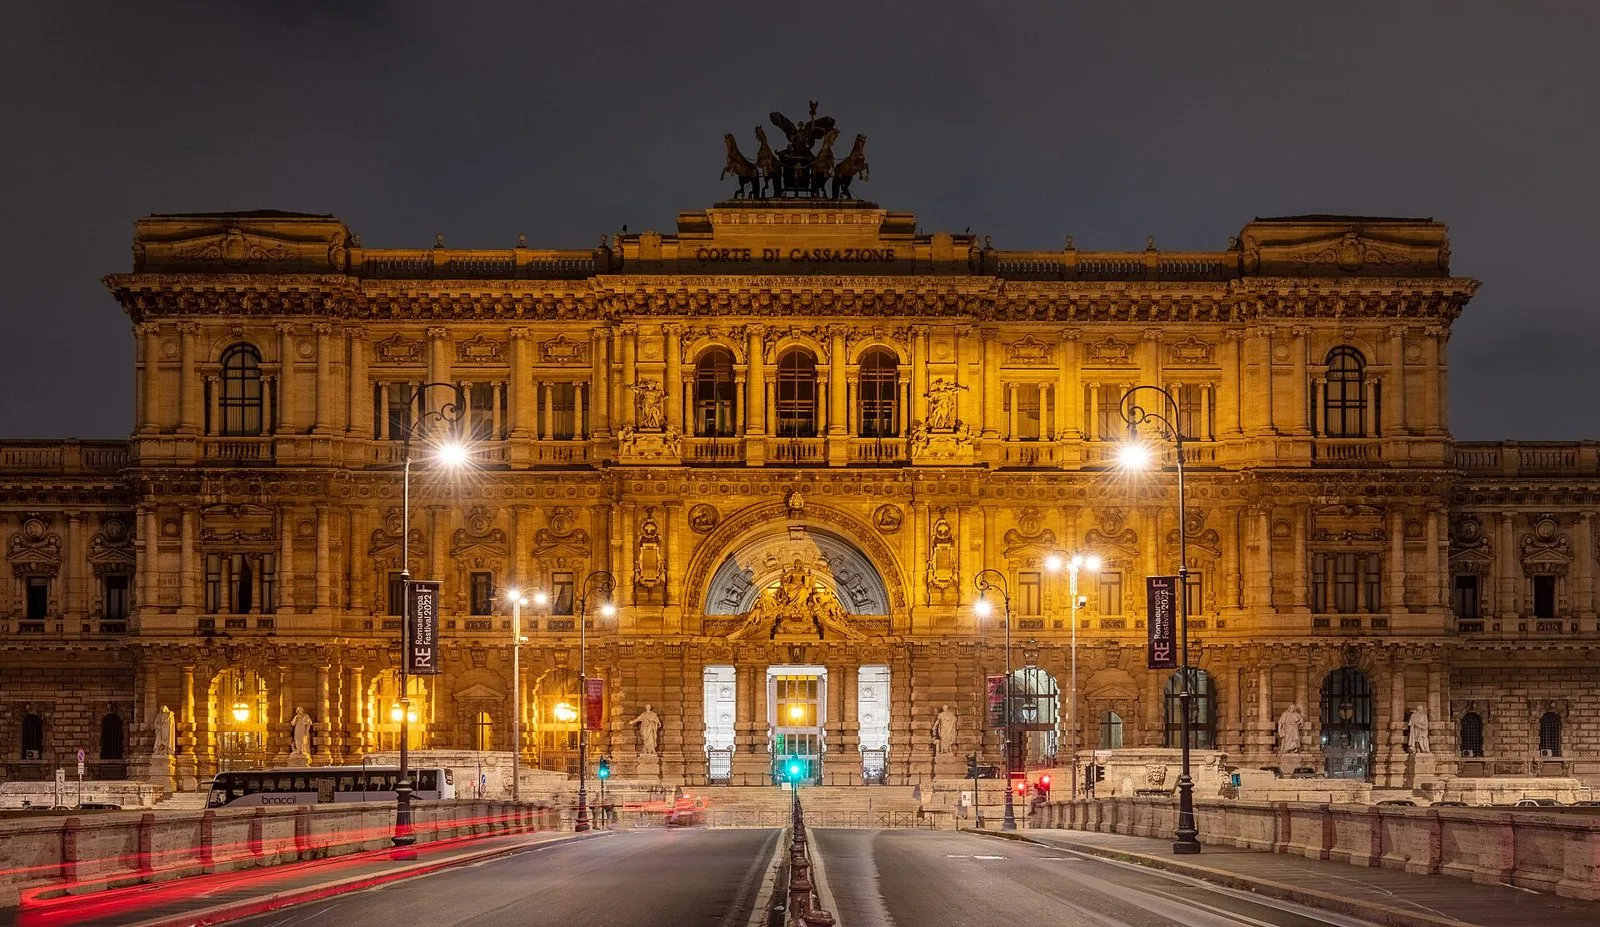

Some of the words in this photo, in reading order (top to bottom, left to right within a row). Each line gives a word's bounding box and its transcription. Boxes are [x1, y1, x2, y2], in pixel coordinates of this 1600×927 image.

[696, 248, 751, 263] CORTE
[762, 248, 780, 262] DI
[789, 248, 896, 262] CASSAZIONE
[416, 583, 432, 592] F
[1153, 579, 1168, 588] F
[424, 594, 432, 616] 2022
[1161, 589, 1169, 609] 2022
[416, 595, 424, 645] Romaeuropa
[1161, 611, 1169, 640] Festival
[424, 617, 432, 645] Festival
[415, 647, 431, 667] RE
[1154, 642, 1170, 661] RE
